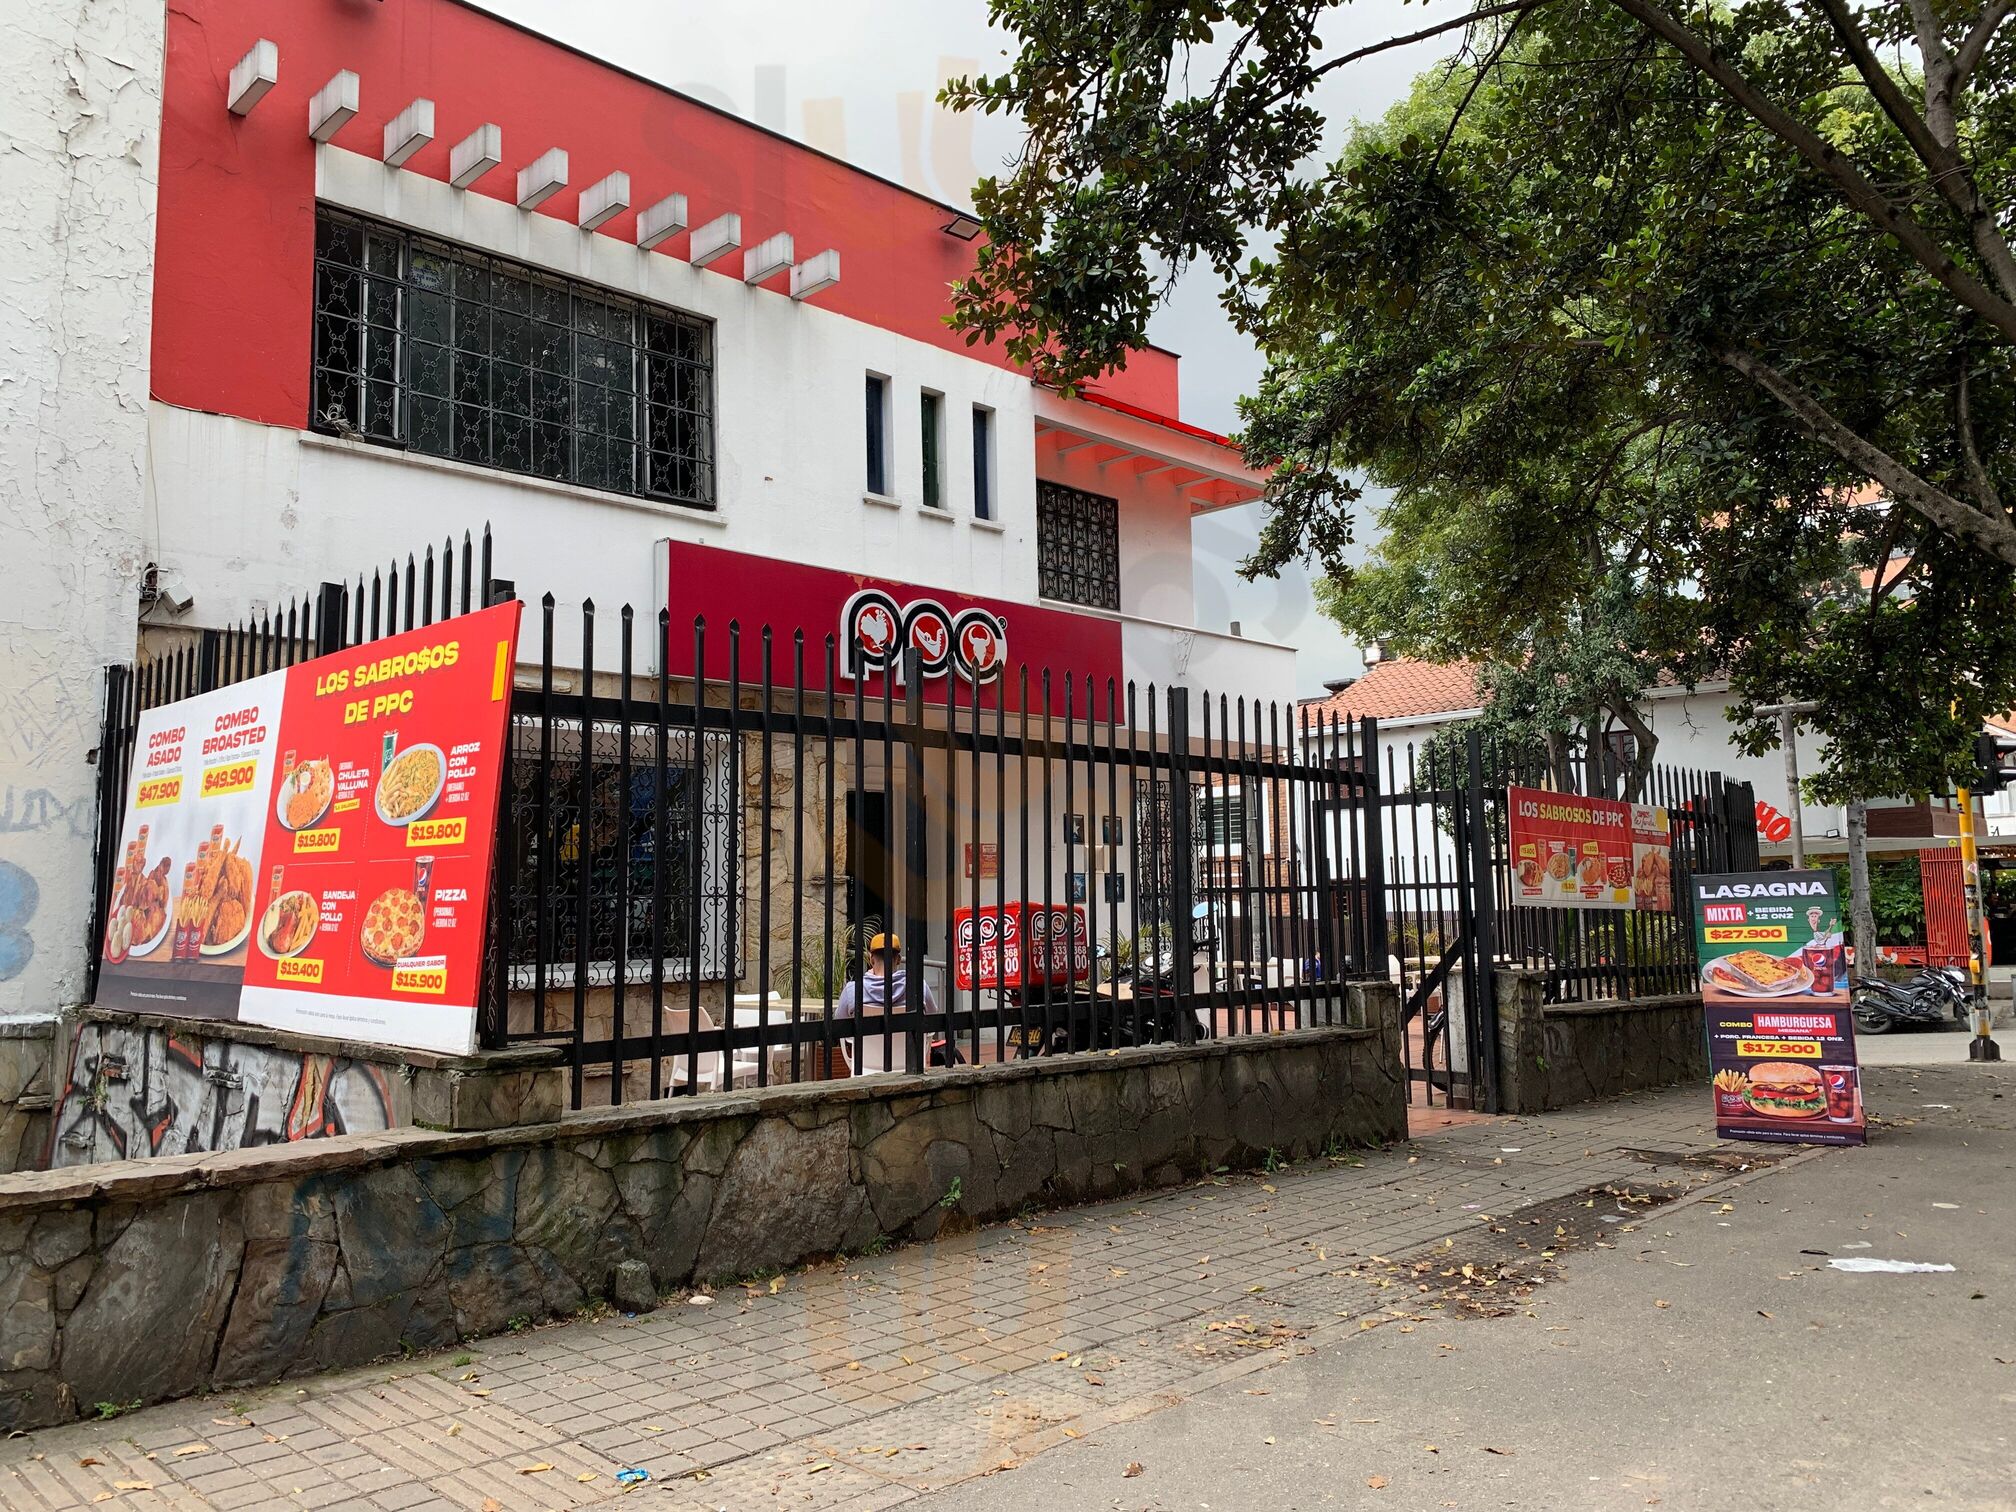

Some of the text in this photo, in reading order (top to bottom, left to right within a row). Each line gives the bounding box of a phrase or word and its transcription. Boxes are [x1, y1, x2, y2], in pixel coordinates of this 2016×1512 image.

[316, 670, 349, 696] LOS
[344, 690, 414, 724] DE PPC
[215, 706, 259, 732] COMBO
[149, 726, 186, 749] COMBO
[202, 725, 266, 755] BROASTED
[147, 746, 181, 767] ASADO
[450, 742, 480, 756] ARROZ
[449, 756, 467, 767] CON
[204, 766, 253, 792] $49.900
[338, 768, 369, 781] CHULETA
[447, 767, 476, 779] POLLO
[139, 781, 180, 804] $47.900
[337, 780, 368, 791] VALLUNA
[1519, 800, 1538, 818] LOS
[1593, 809, 1605, 826] DE
[1606, 811, 1624, 828] PPC
[411, 822, 461, 842] $19.800
[297, 833, 337, 849] $19.800
[322, 890, 356, 900] BANDEJA
[434, 889, 467, 901] PIZZA
[1699, 881, 1828, 899] LASAGNA
[321, 902, 336, 910] CON
[320, 912, 343, 922] POLLO
[1706, 907, 1744, 922] MIXTA
[1710, 929, 1783, 940] $27.900
[280, 960, 320, 978] $19.400
[396, 971, 442, 989] $15.900
[1757, 1016, 1833, 1029] HAMBURGUESA
[1743, 1042, 1815, 1054] $17.900
